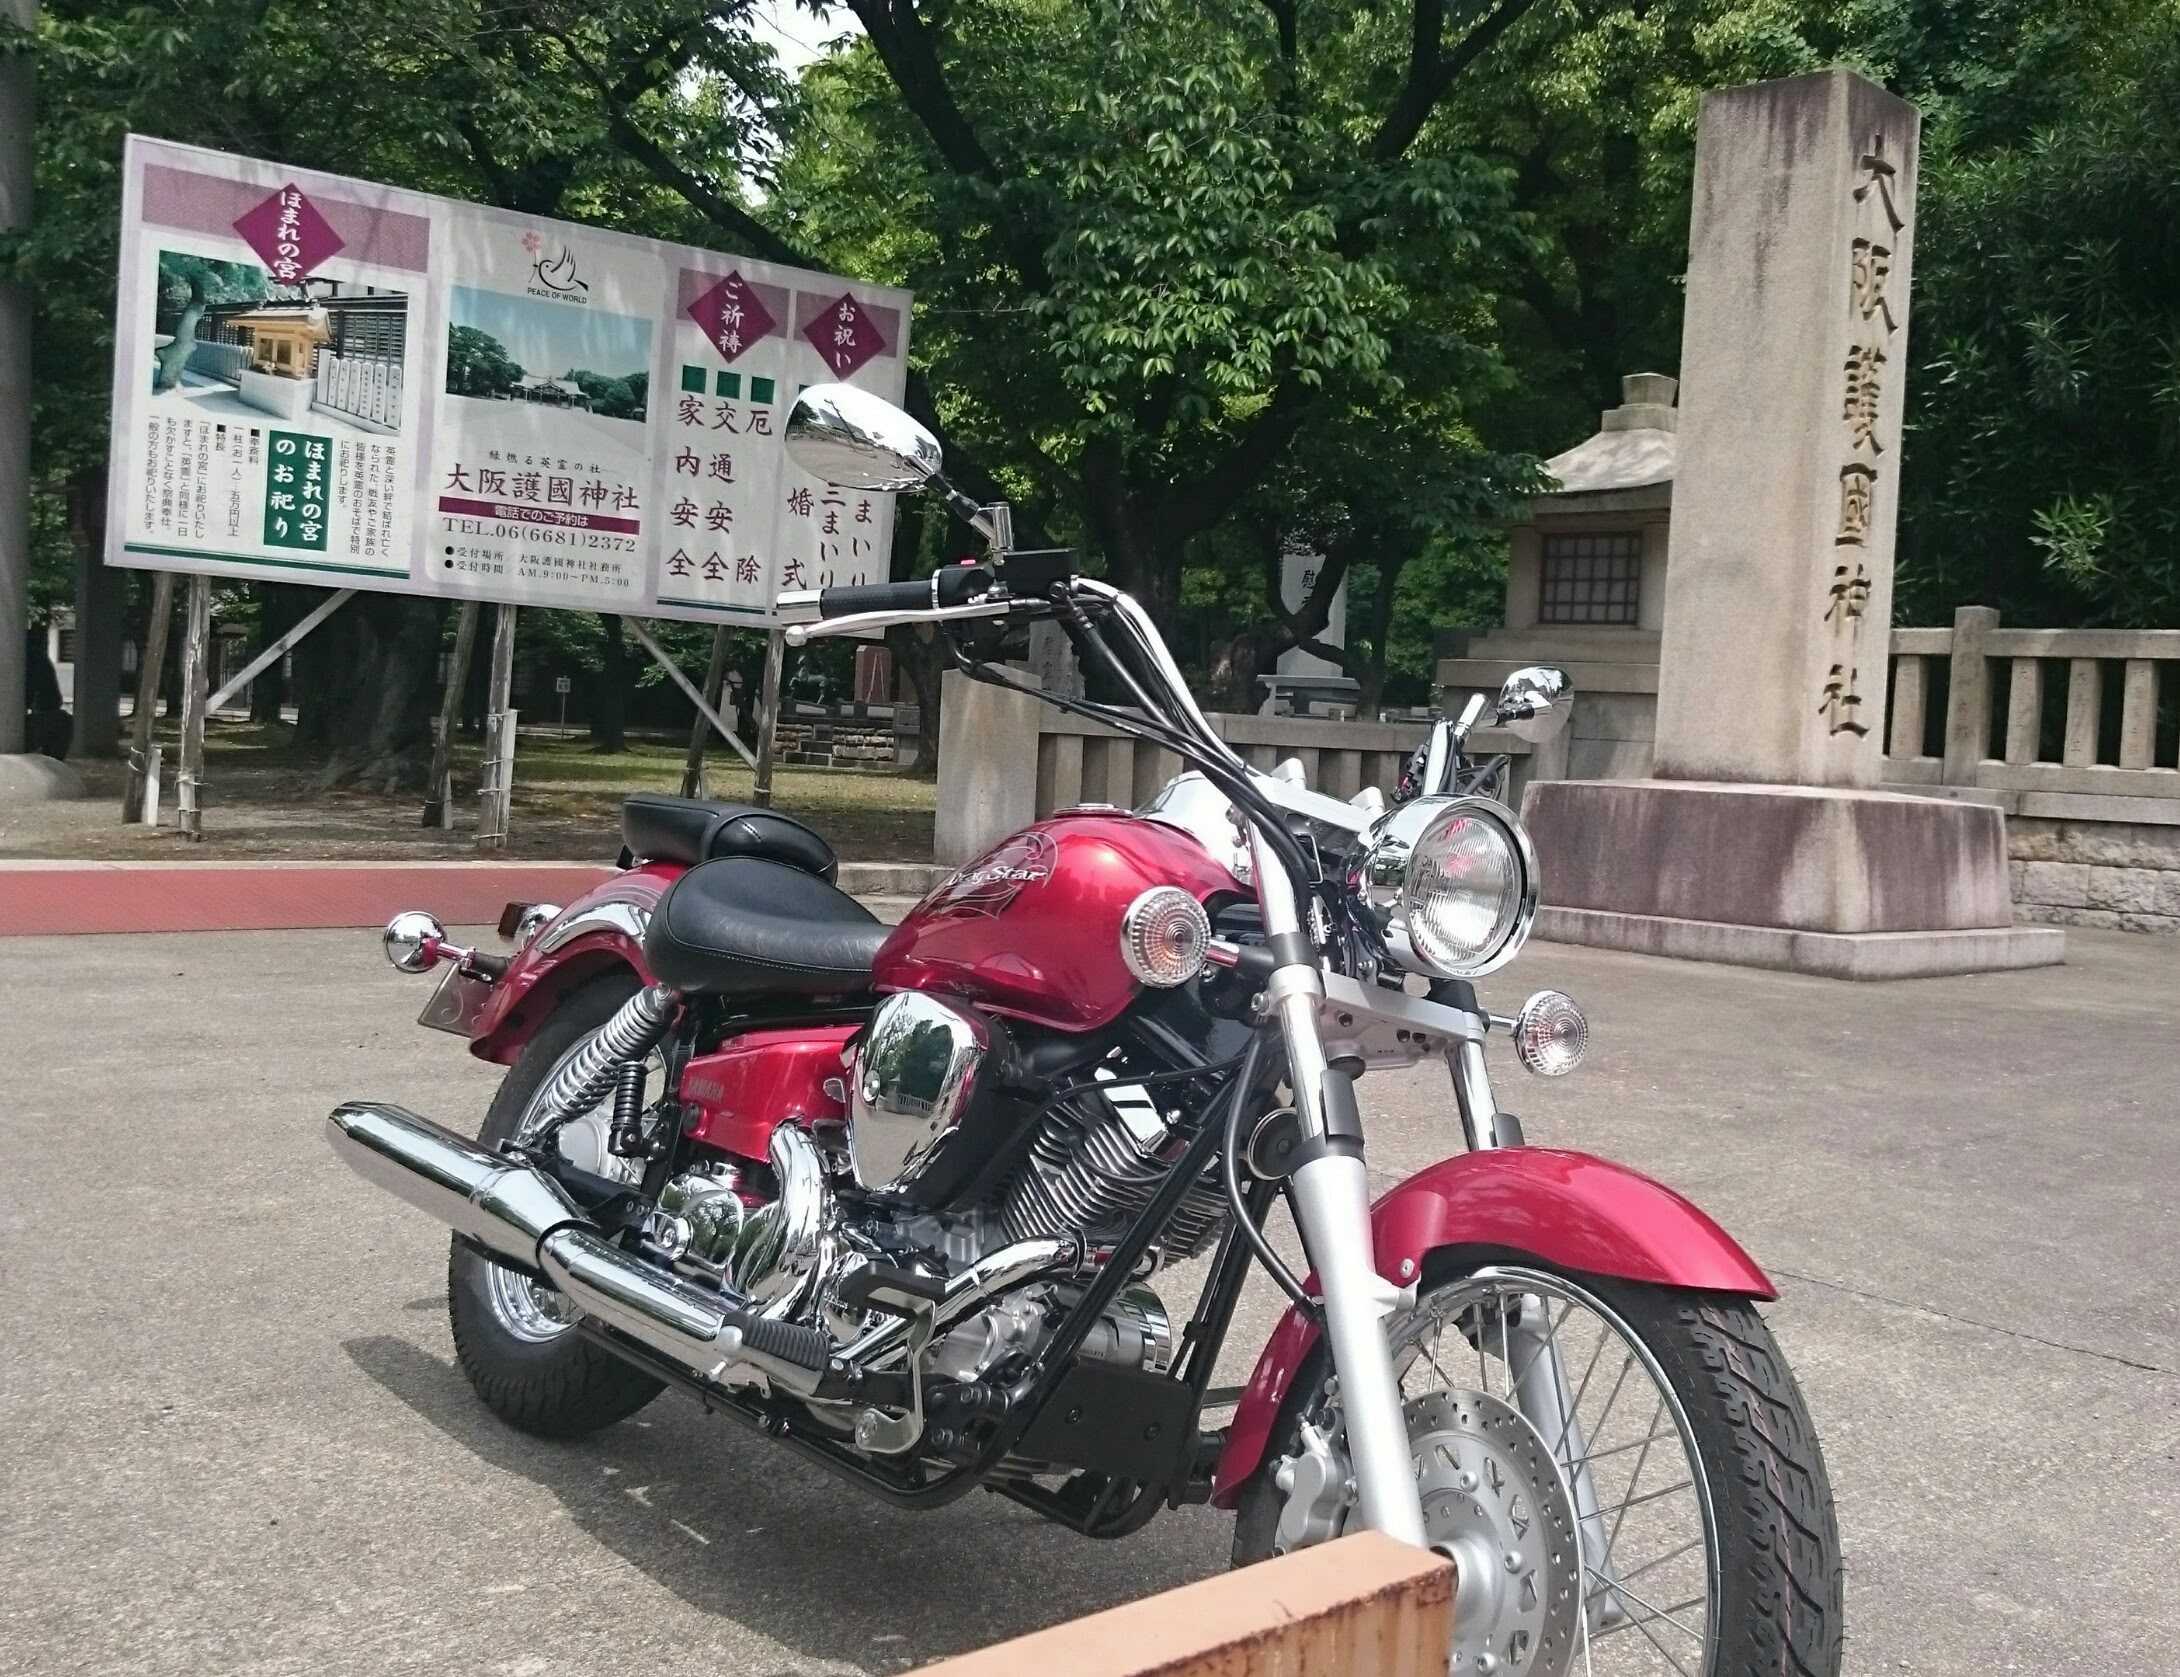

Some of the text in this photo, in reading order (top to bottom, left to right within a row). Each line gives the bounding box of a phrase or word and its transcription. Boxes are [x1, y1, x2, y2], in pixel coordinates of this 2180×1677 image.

[274, 190, 303, 280] ほまれの宮
[527, 287, 587, 304] PEACE OF WORLD
[833, 302, 856, 368] お祝い
[1818, 133, 1905, 740] 大阪護國神社
[271, 438, 297, 539] のお祀り
[299, 440, 326, 542] ほまれの宮
[444, 463, 641, 512] 大阪護國神社
[494, 505, 589, 527] 電話でのご予約は
[666, 395, 705, 578] 家内安全
[700, 402, 739, 582] 交通安全
[456, 560, 504, 575] 受付時間
[457, 546, 504, 562] 受付場所
